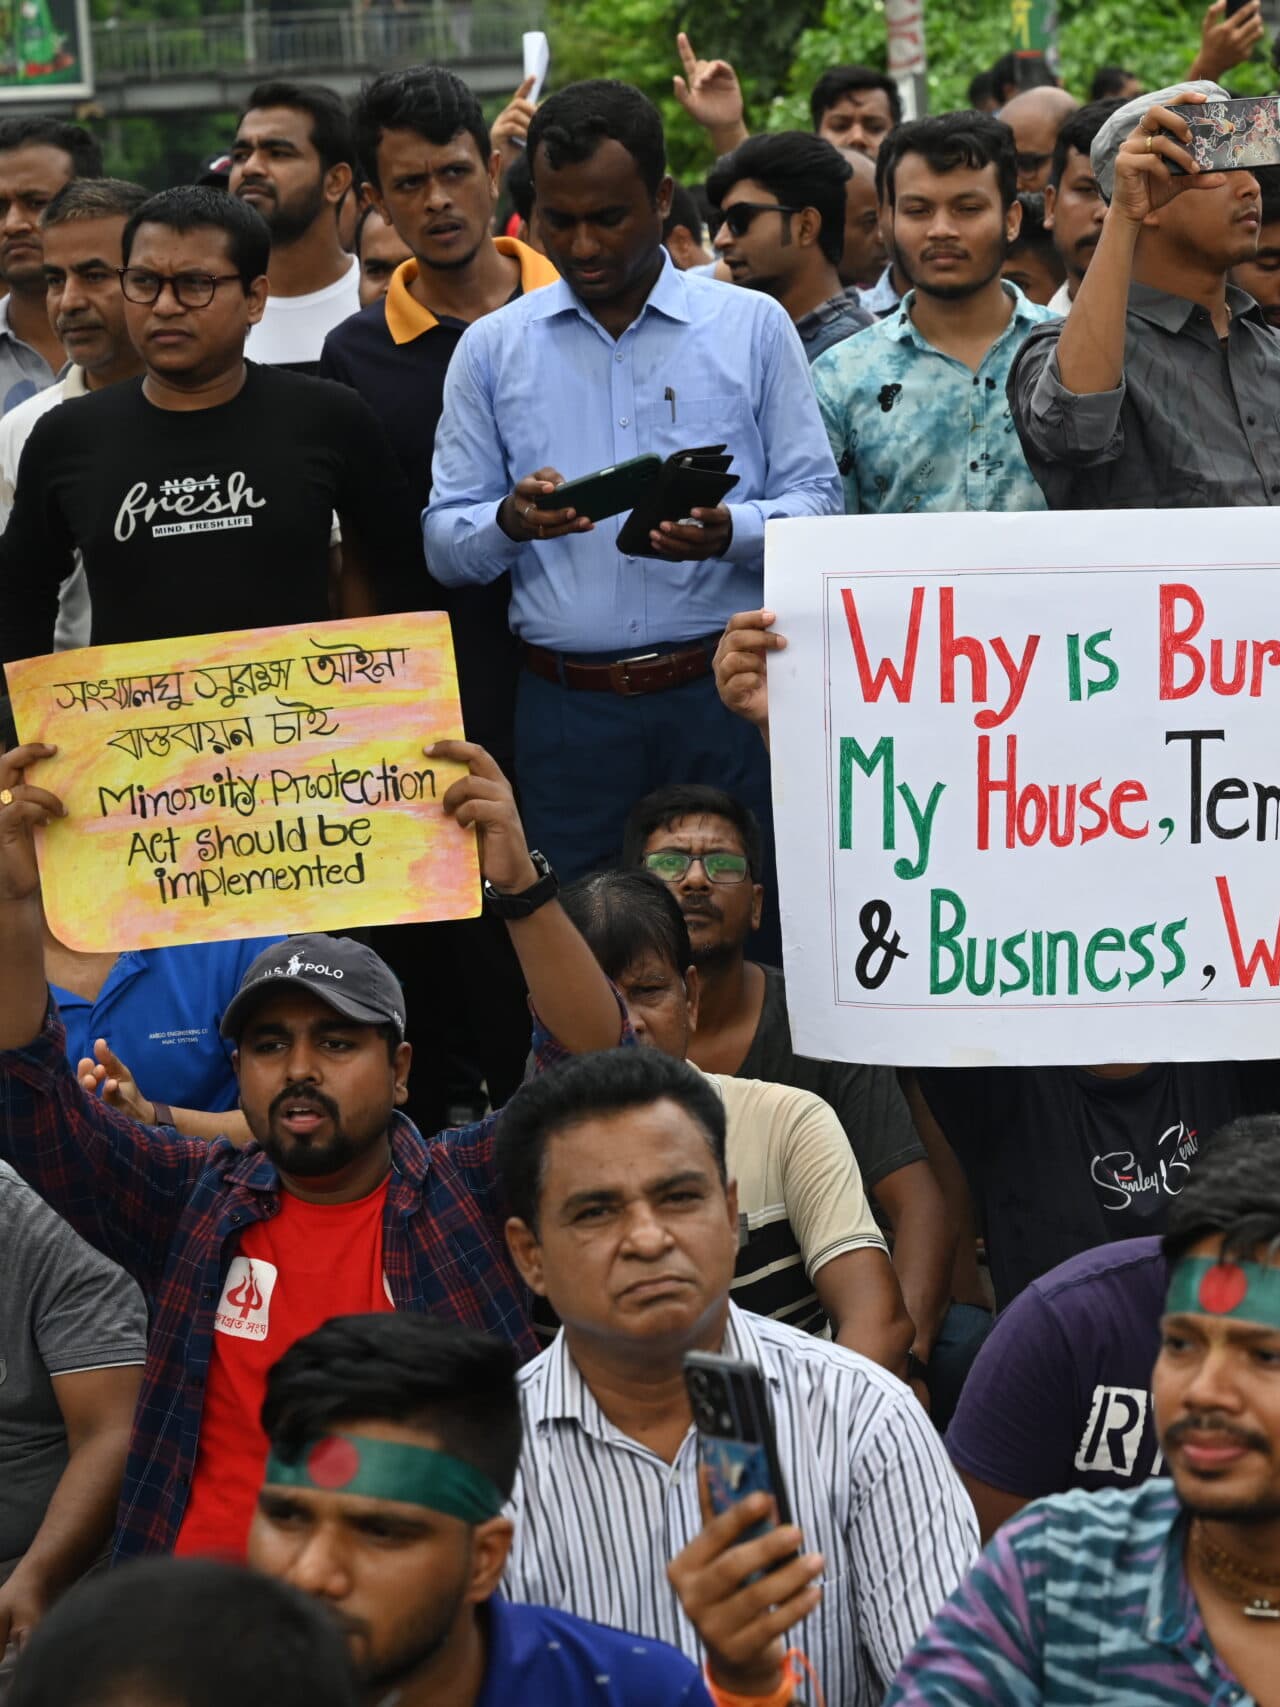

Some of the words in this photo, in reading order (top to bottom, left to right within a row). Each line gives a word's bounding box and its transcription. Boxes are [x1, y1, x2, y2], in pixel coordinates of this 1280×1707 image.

[114, 471, 267, 541] fresh
[189, 521, 224, 532] FRESH
[227, 517, 251, 527] LIFE
[840, 585, 1041, 729] Why
[265, 696, 340, 744] চাই
[98, 767, 260, 819] Minority
[271, 758, 436, 806] Protection
[839, 736, 946, 880] My
[128, 826, 181, 866] Act
[317, 814, 372, 846] be
[153, 852, 365, 907] implemented
[304, 963, 344, 980] POLO
[854, 899, 909, 990] &
